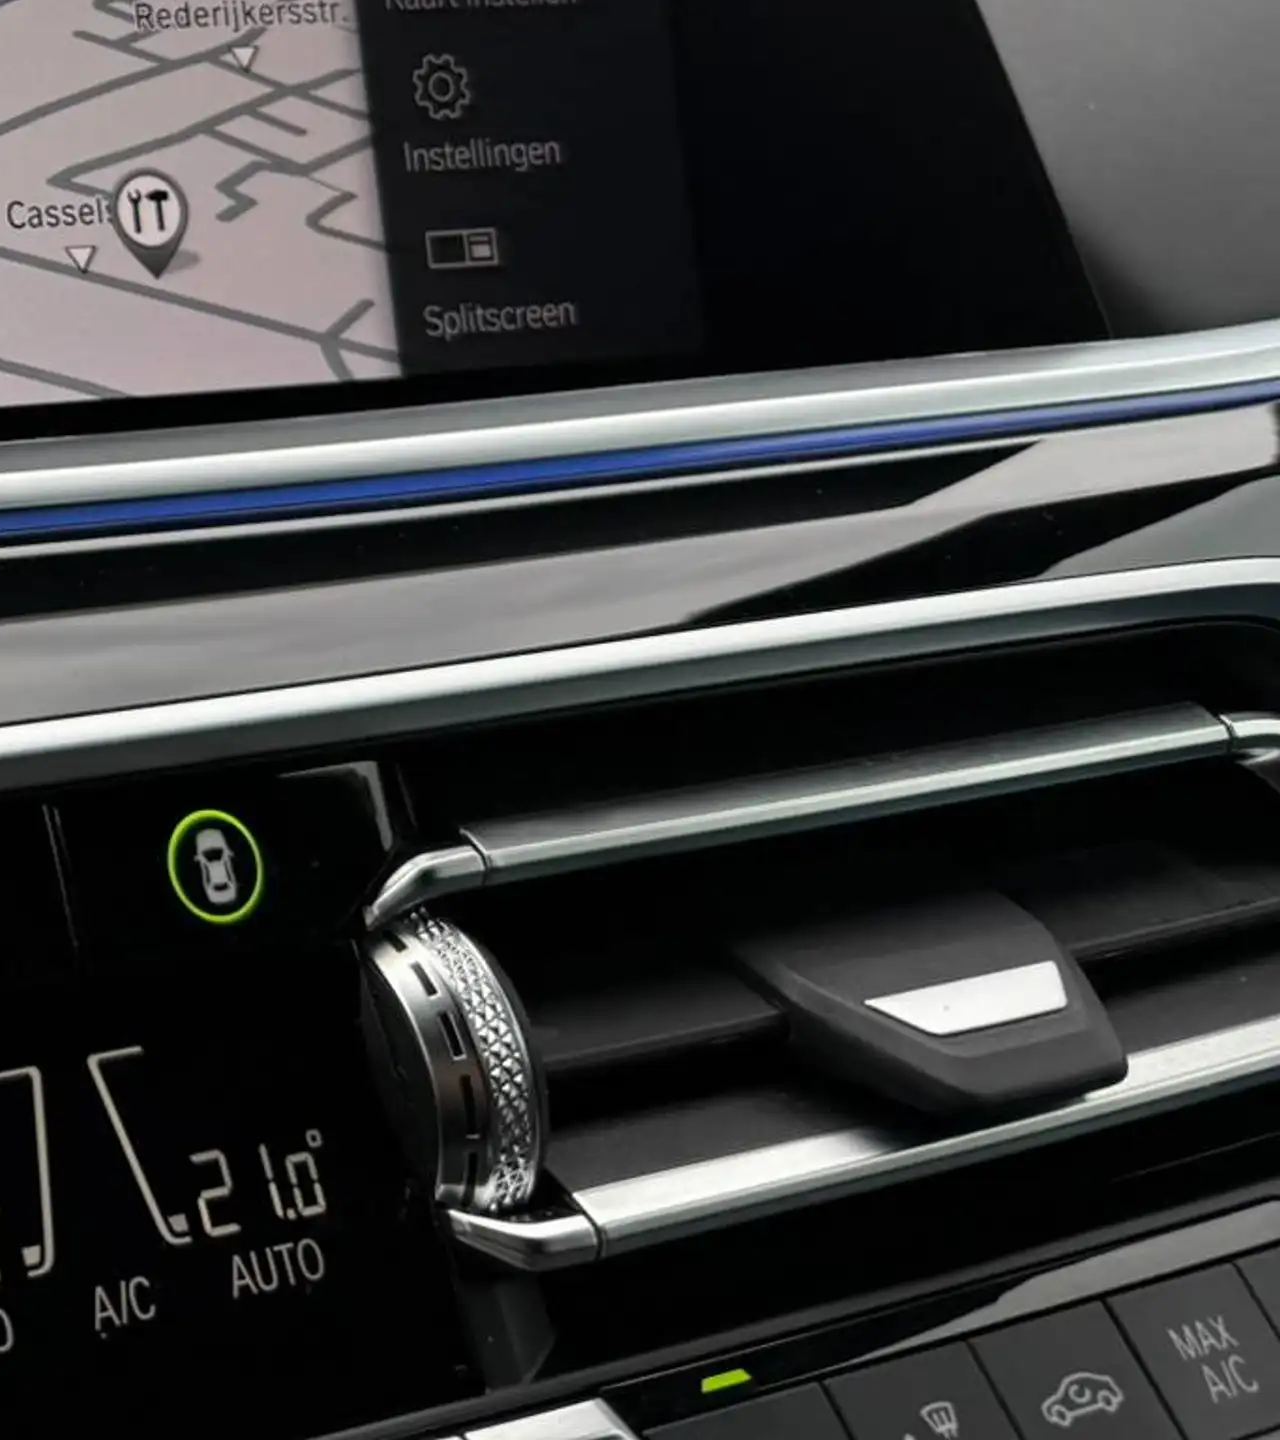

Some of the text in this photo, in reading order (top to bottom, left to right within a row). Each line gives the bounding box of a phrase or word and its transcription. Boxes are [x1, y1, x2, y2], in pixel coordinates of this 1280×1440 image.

[404, 137, 562, 174] Instellingen
[423, 297, 577, 341] Splitscreen
[230, 1238, 326, 1299] AUTO
[94, 1275, 157, 1332] A/C
[1167, 1315, 1240, 1359] MAX
[1201, 1354, 1259, 1404] A/C
